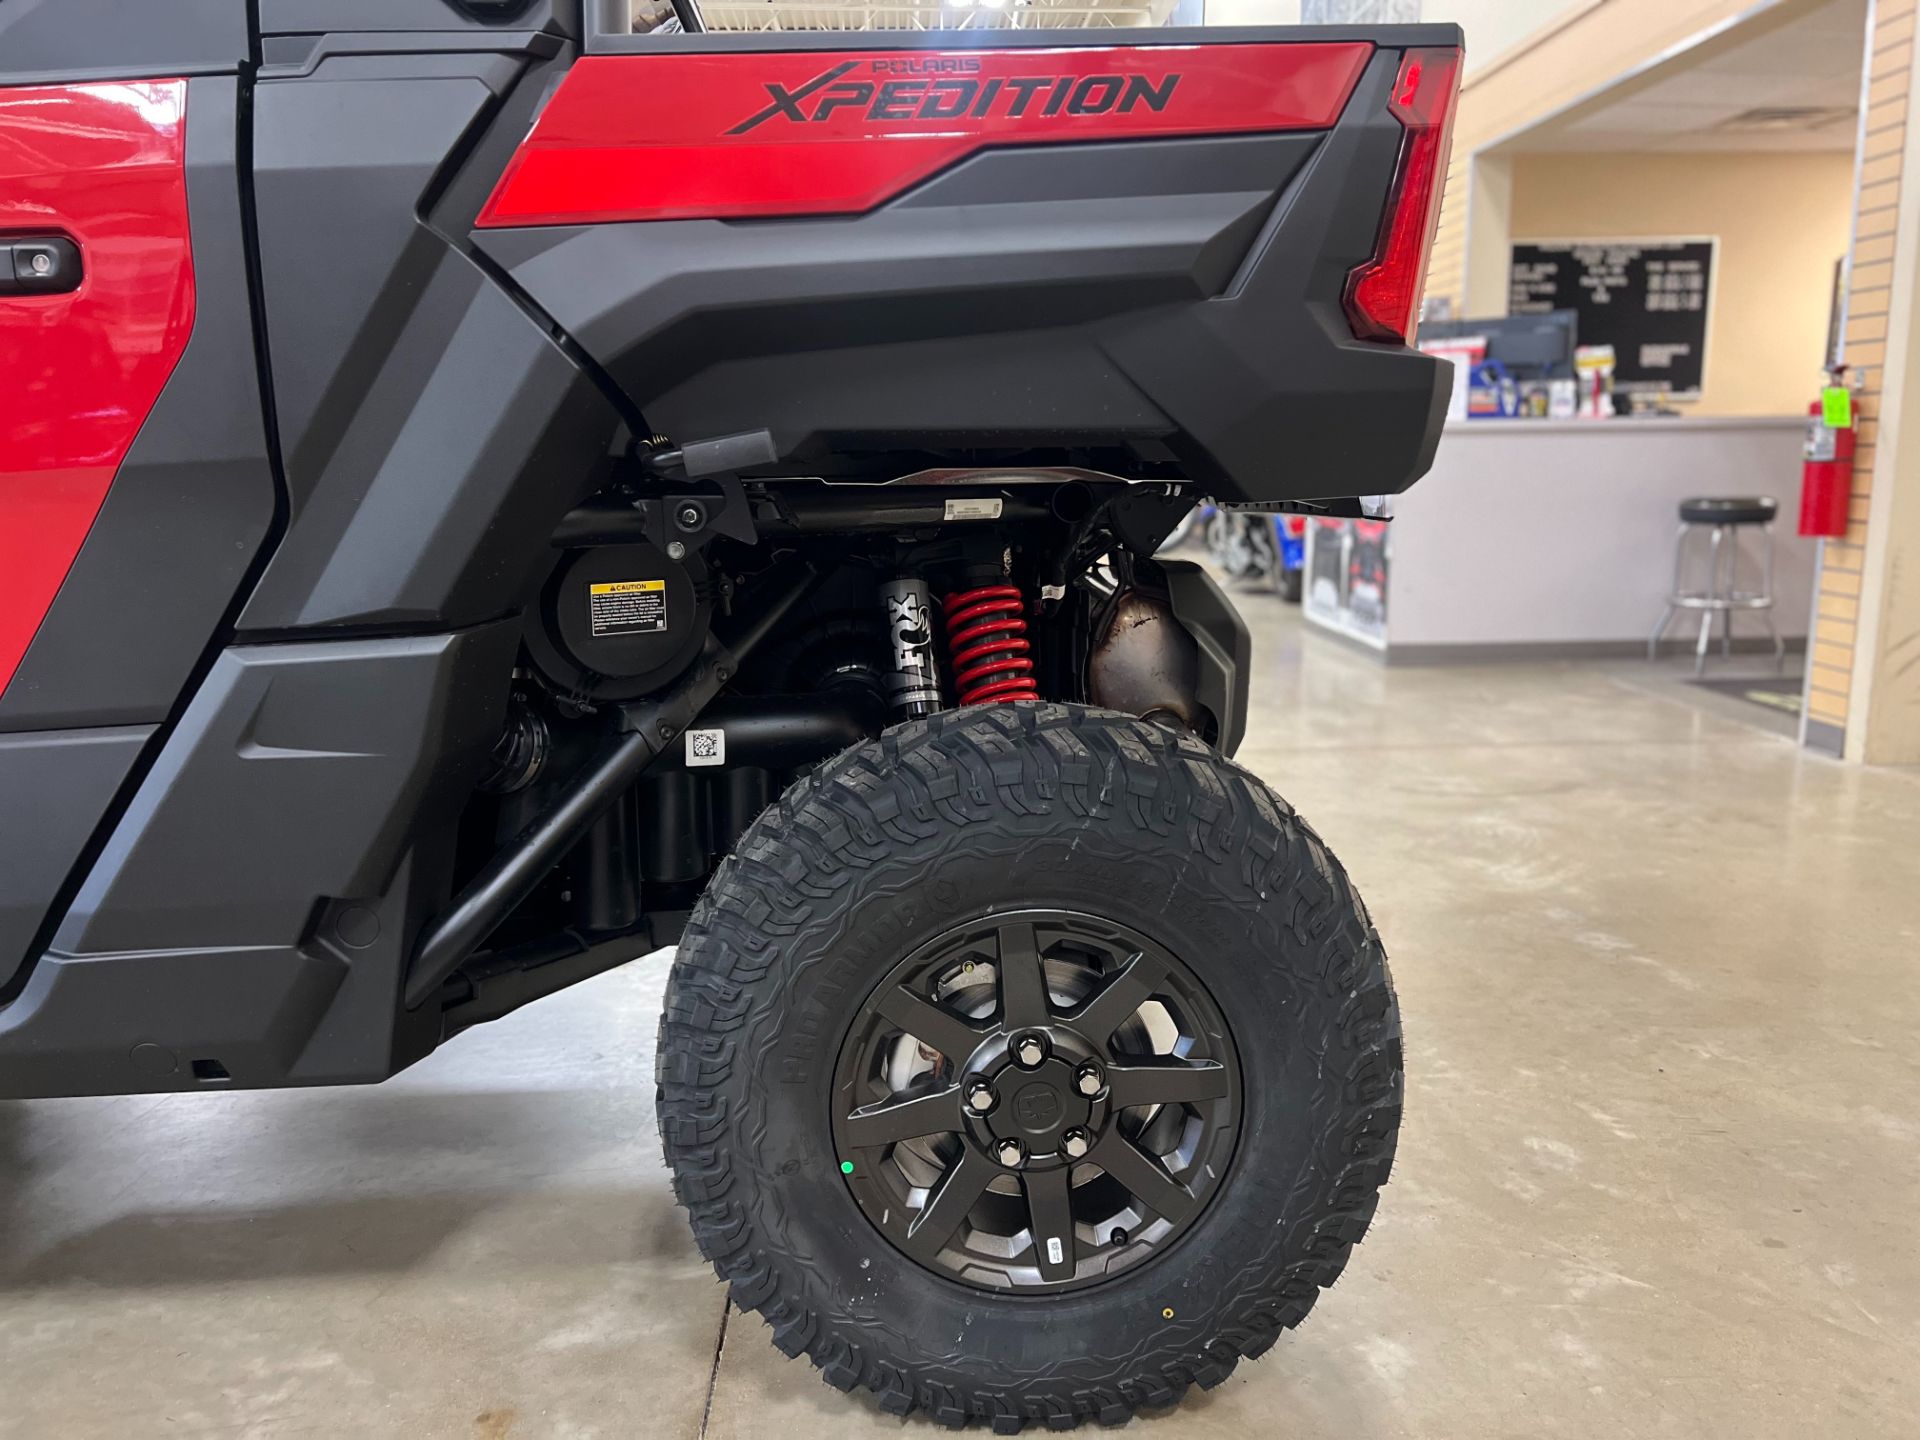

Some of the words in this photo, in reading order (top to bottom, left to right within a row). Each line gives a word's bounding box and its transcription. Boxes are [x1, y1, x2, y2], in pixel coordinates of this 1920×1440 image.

[872, 59, 981, 73] POLARIS
[723, 60, 1182, 135] XPEDITION
[616, 583, 646, 591] CAUTION
[887, 593, 927, 671] FOX
